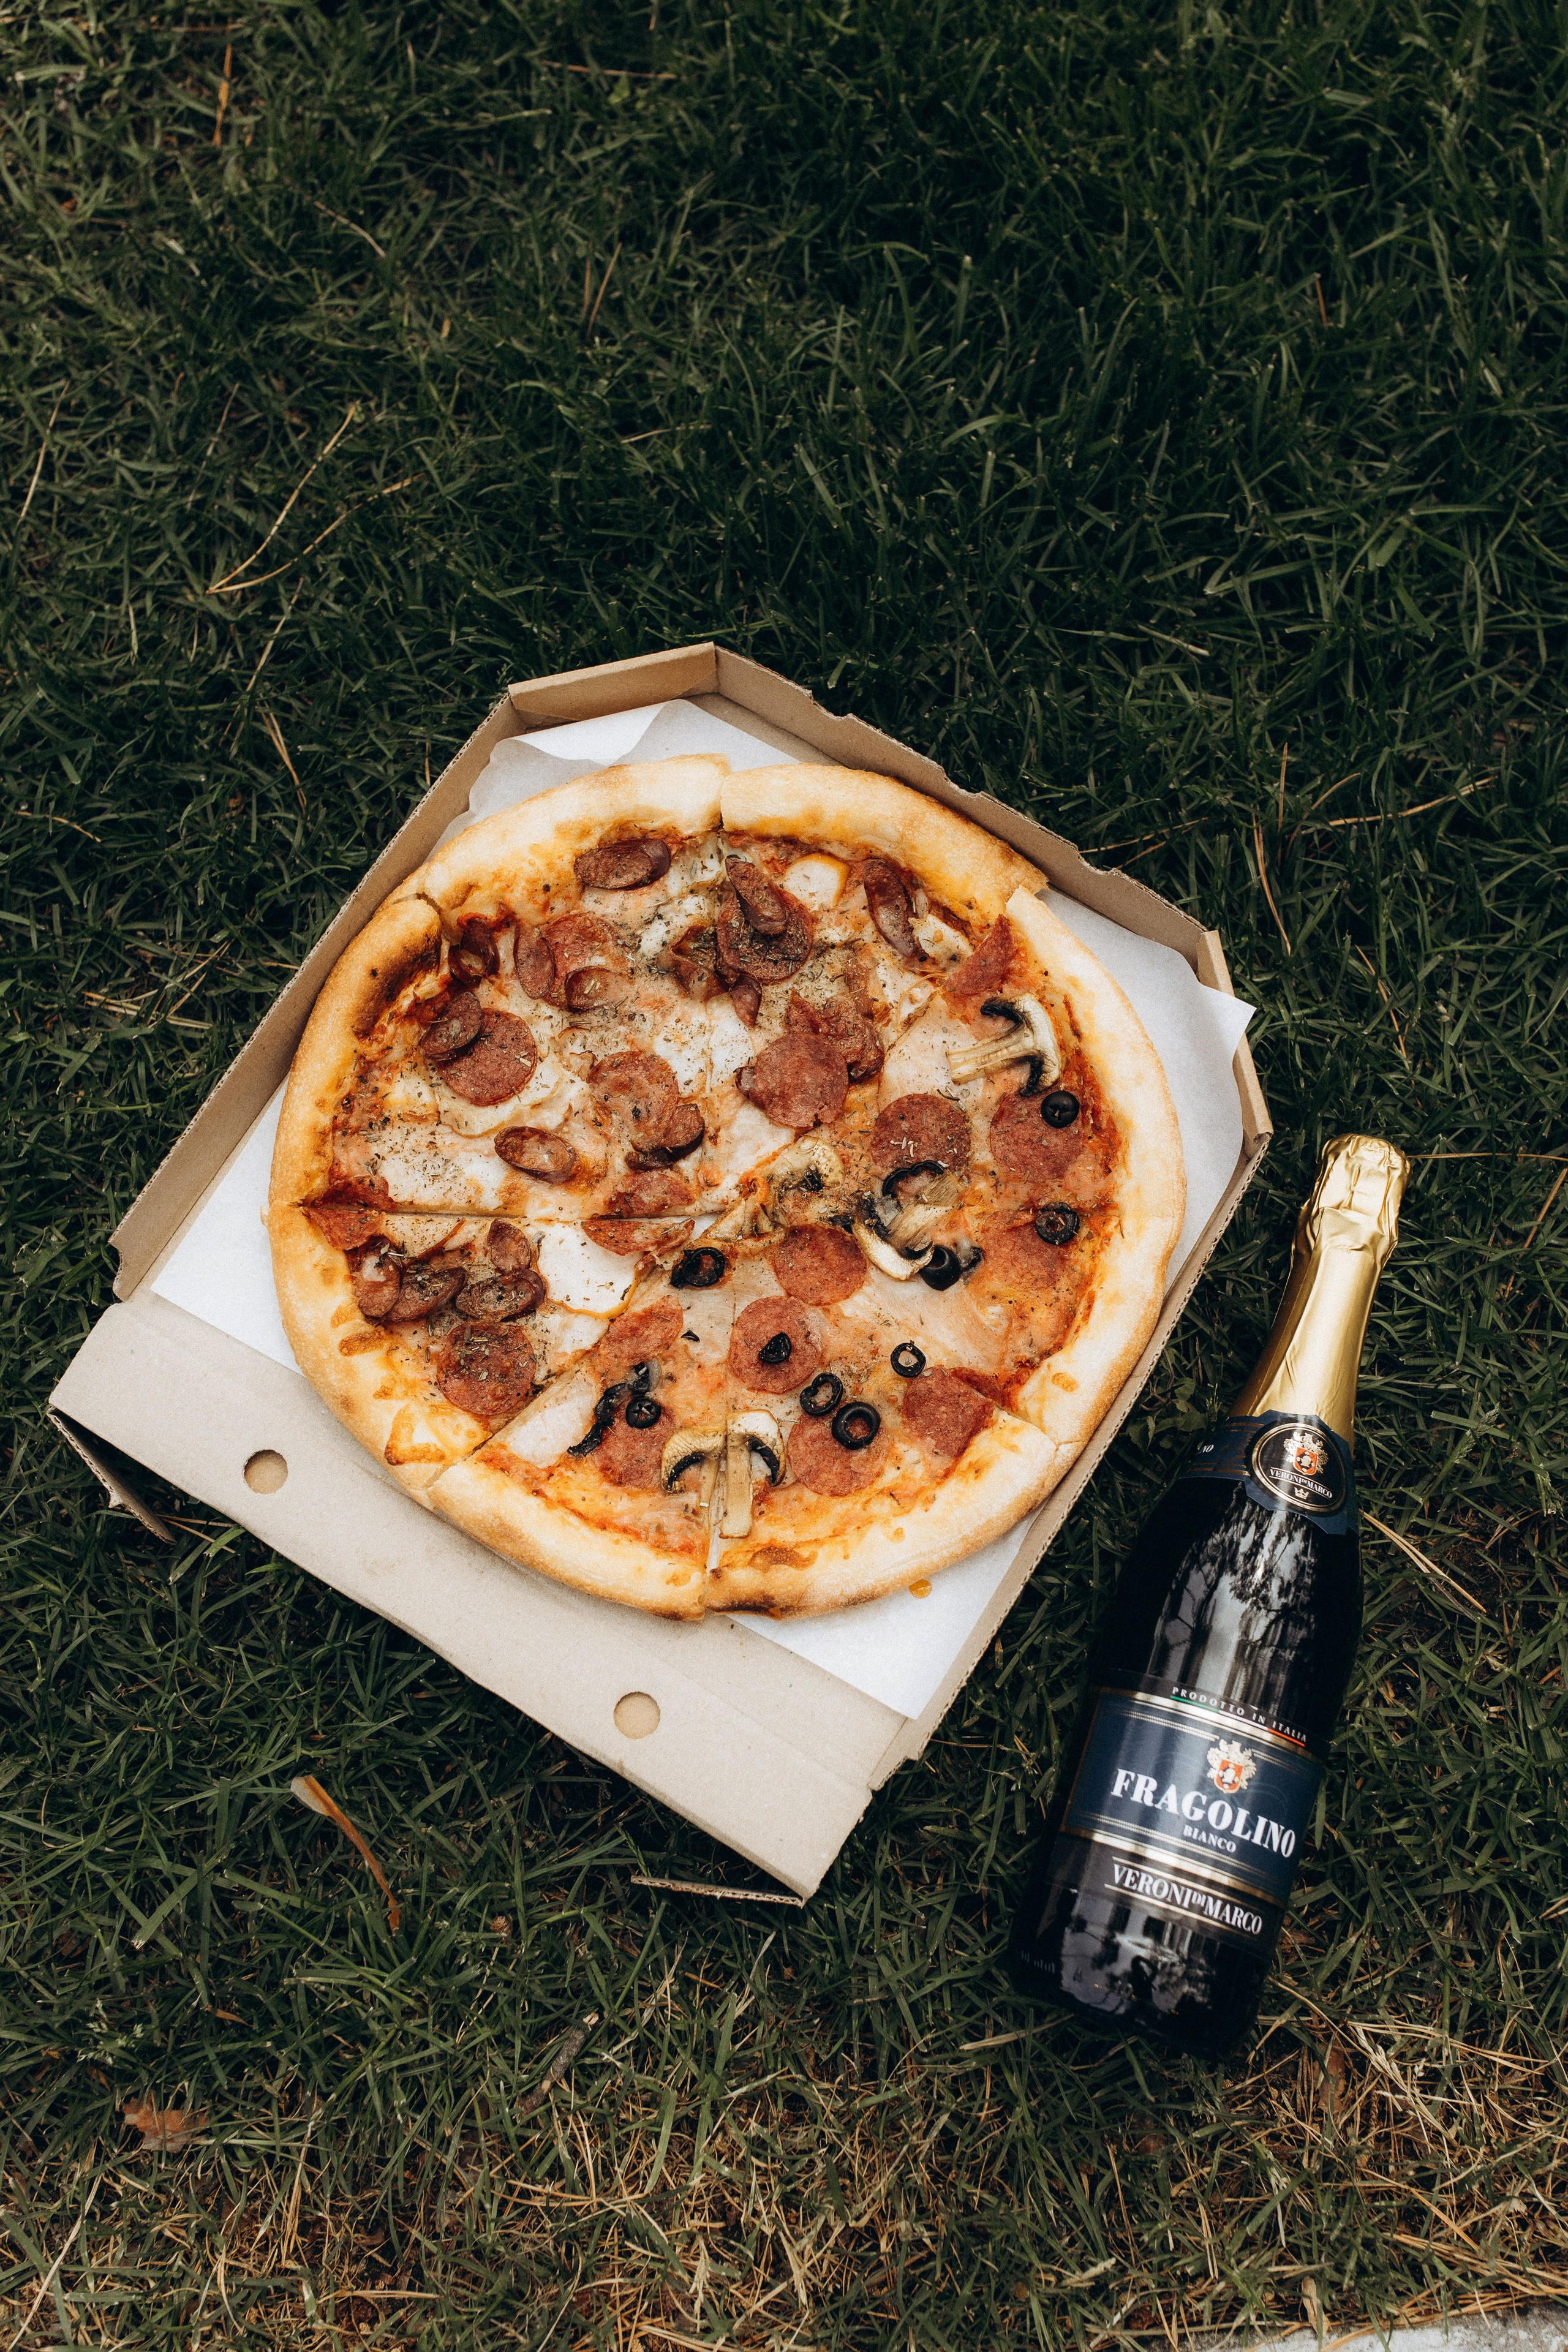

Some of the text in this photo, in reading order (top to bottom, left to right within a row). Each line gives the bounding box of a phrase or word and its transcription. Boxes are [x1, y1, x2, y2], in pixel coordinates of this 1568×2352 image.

[1172, 1686, 1306, 1742] PRODOTTO IN ITALIA
[1110, 1768, 1295, 1858] FRAGOLINO
[1183, 1825, 1237, 1853] BIANCO
